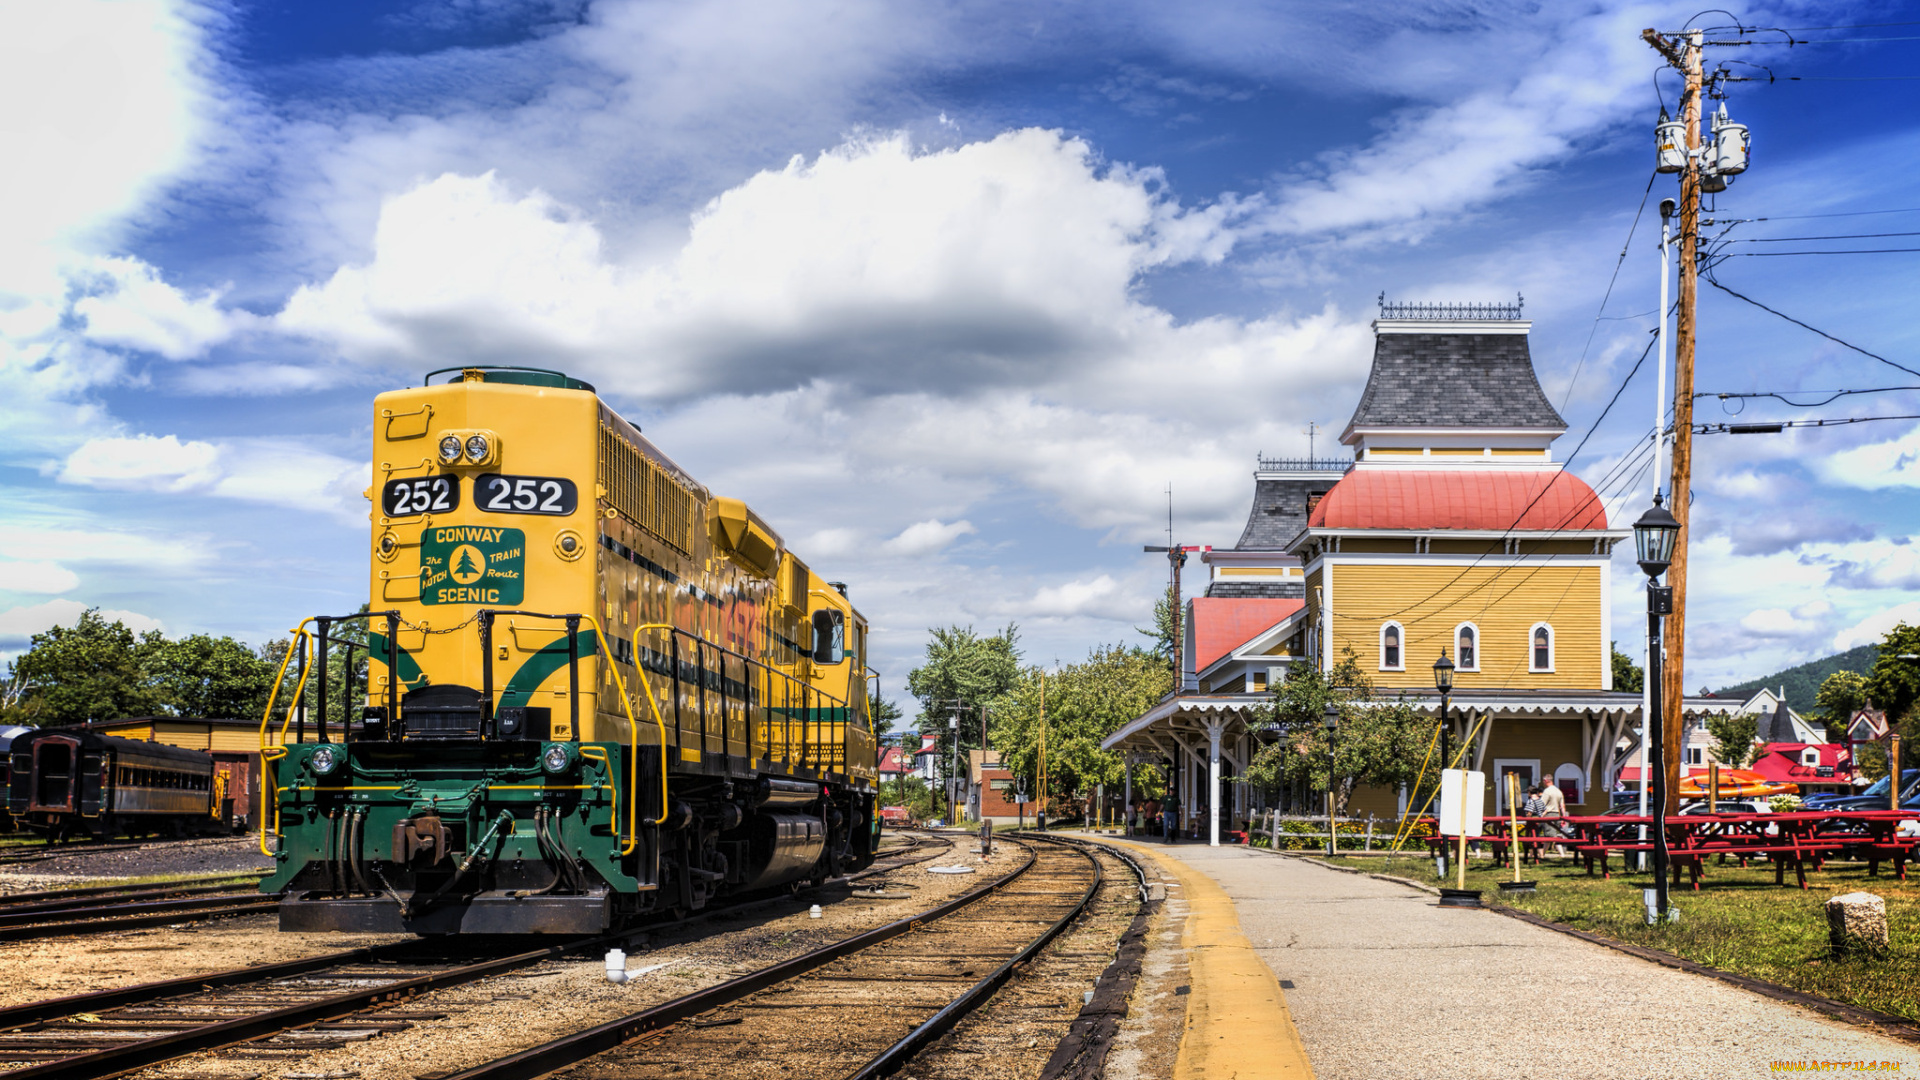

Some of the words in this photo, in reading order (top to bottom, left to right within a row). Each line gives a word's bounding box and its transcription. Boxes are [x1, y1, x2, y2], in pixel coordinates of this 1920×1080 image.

[393, 479, 450, 514] 252
[488, 479, 563, 512] 252
[436, 527, 504, 543] CONWAY
[425, 556, 442, 565] The
[489, 547, 520, 564] TRAIN
[422, 570, 447, 590] NOTCH
[486, 568, 520, 579] Route
[438, 588, 500, 603] SCENIC
